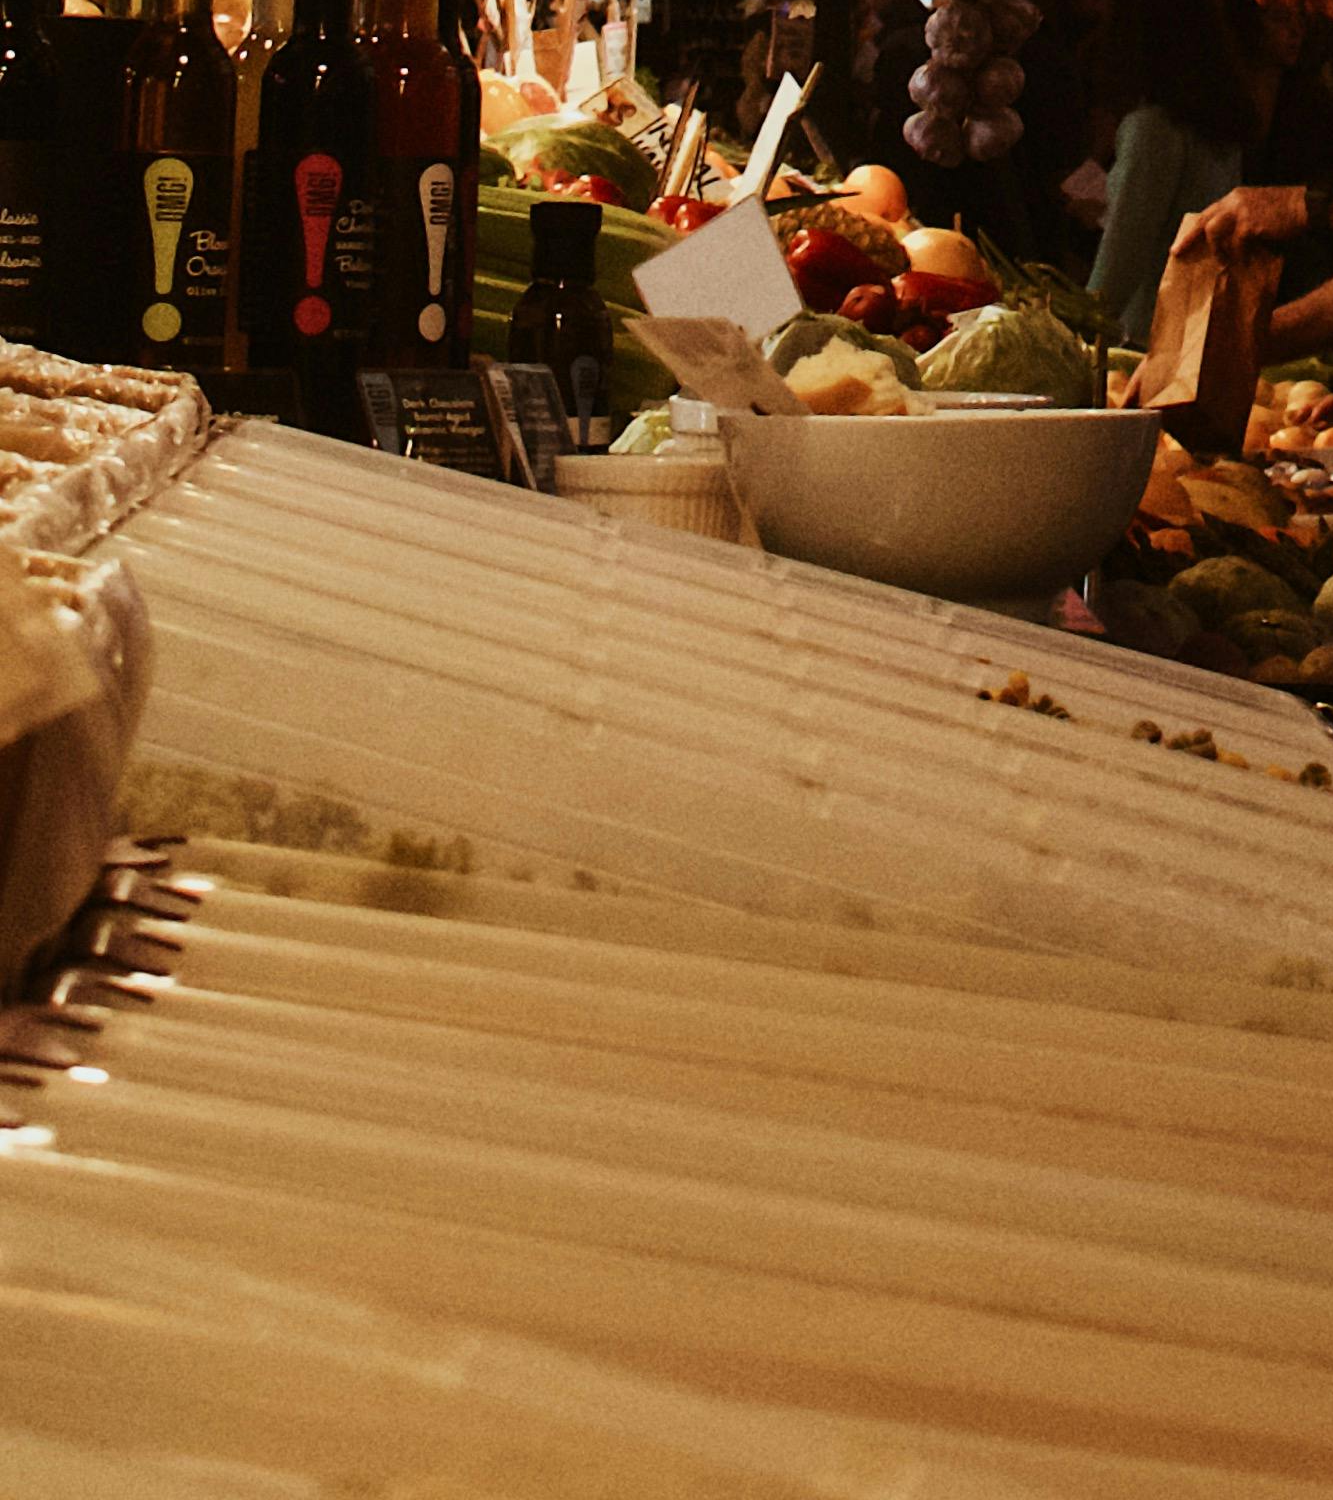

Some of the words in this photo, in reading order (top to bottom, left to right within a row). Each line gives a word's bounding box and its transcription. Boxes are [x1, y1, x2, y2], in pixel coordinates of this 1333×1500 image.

[155, 176, 188, 222] OMG!
[306, 171, 337, 217] OMG!
[430, 181, 451, 225] OMG!
